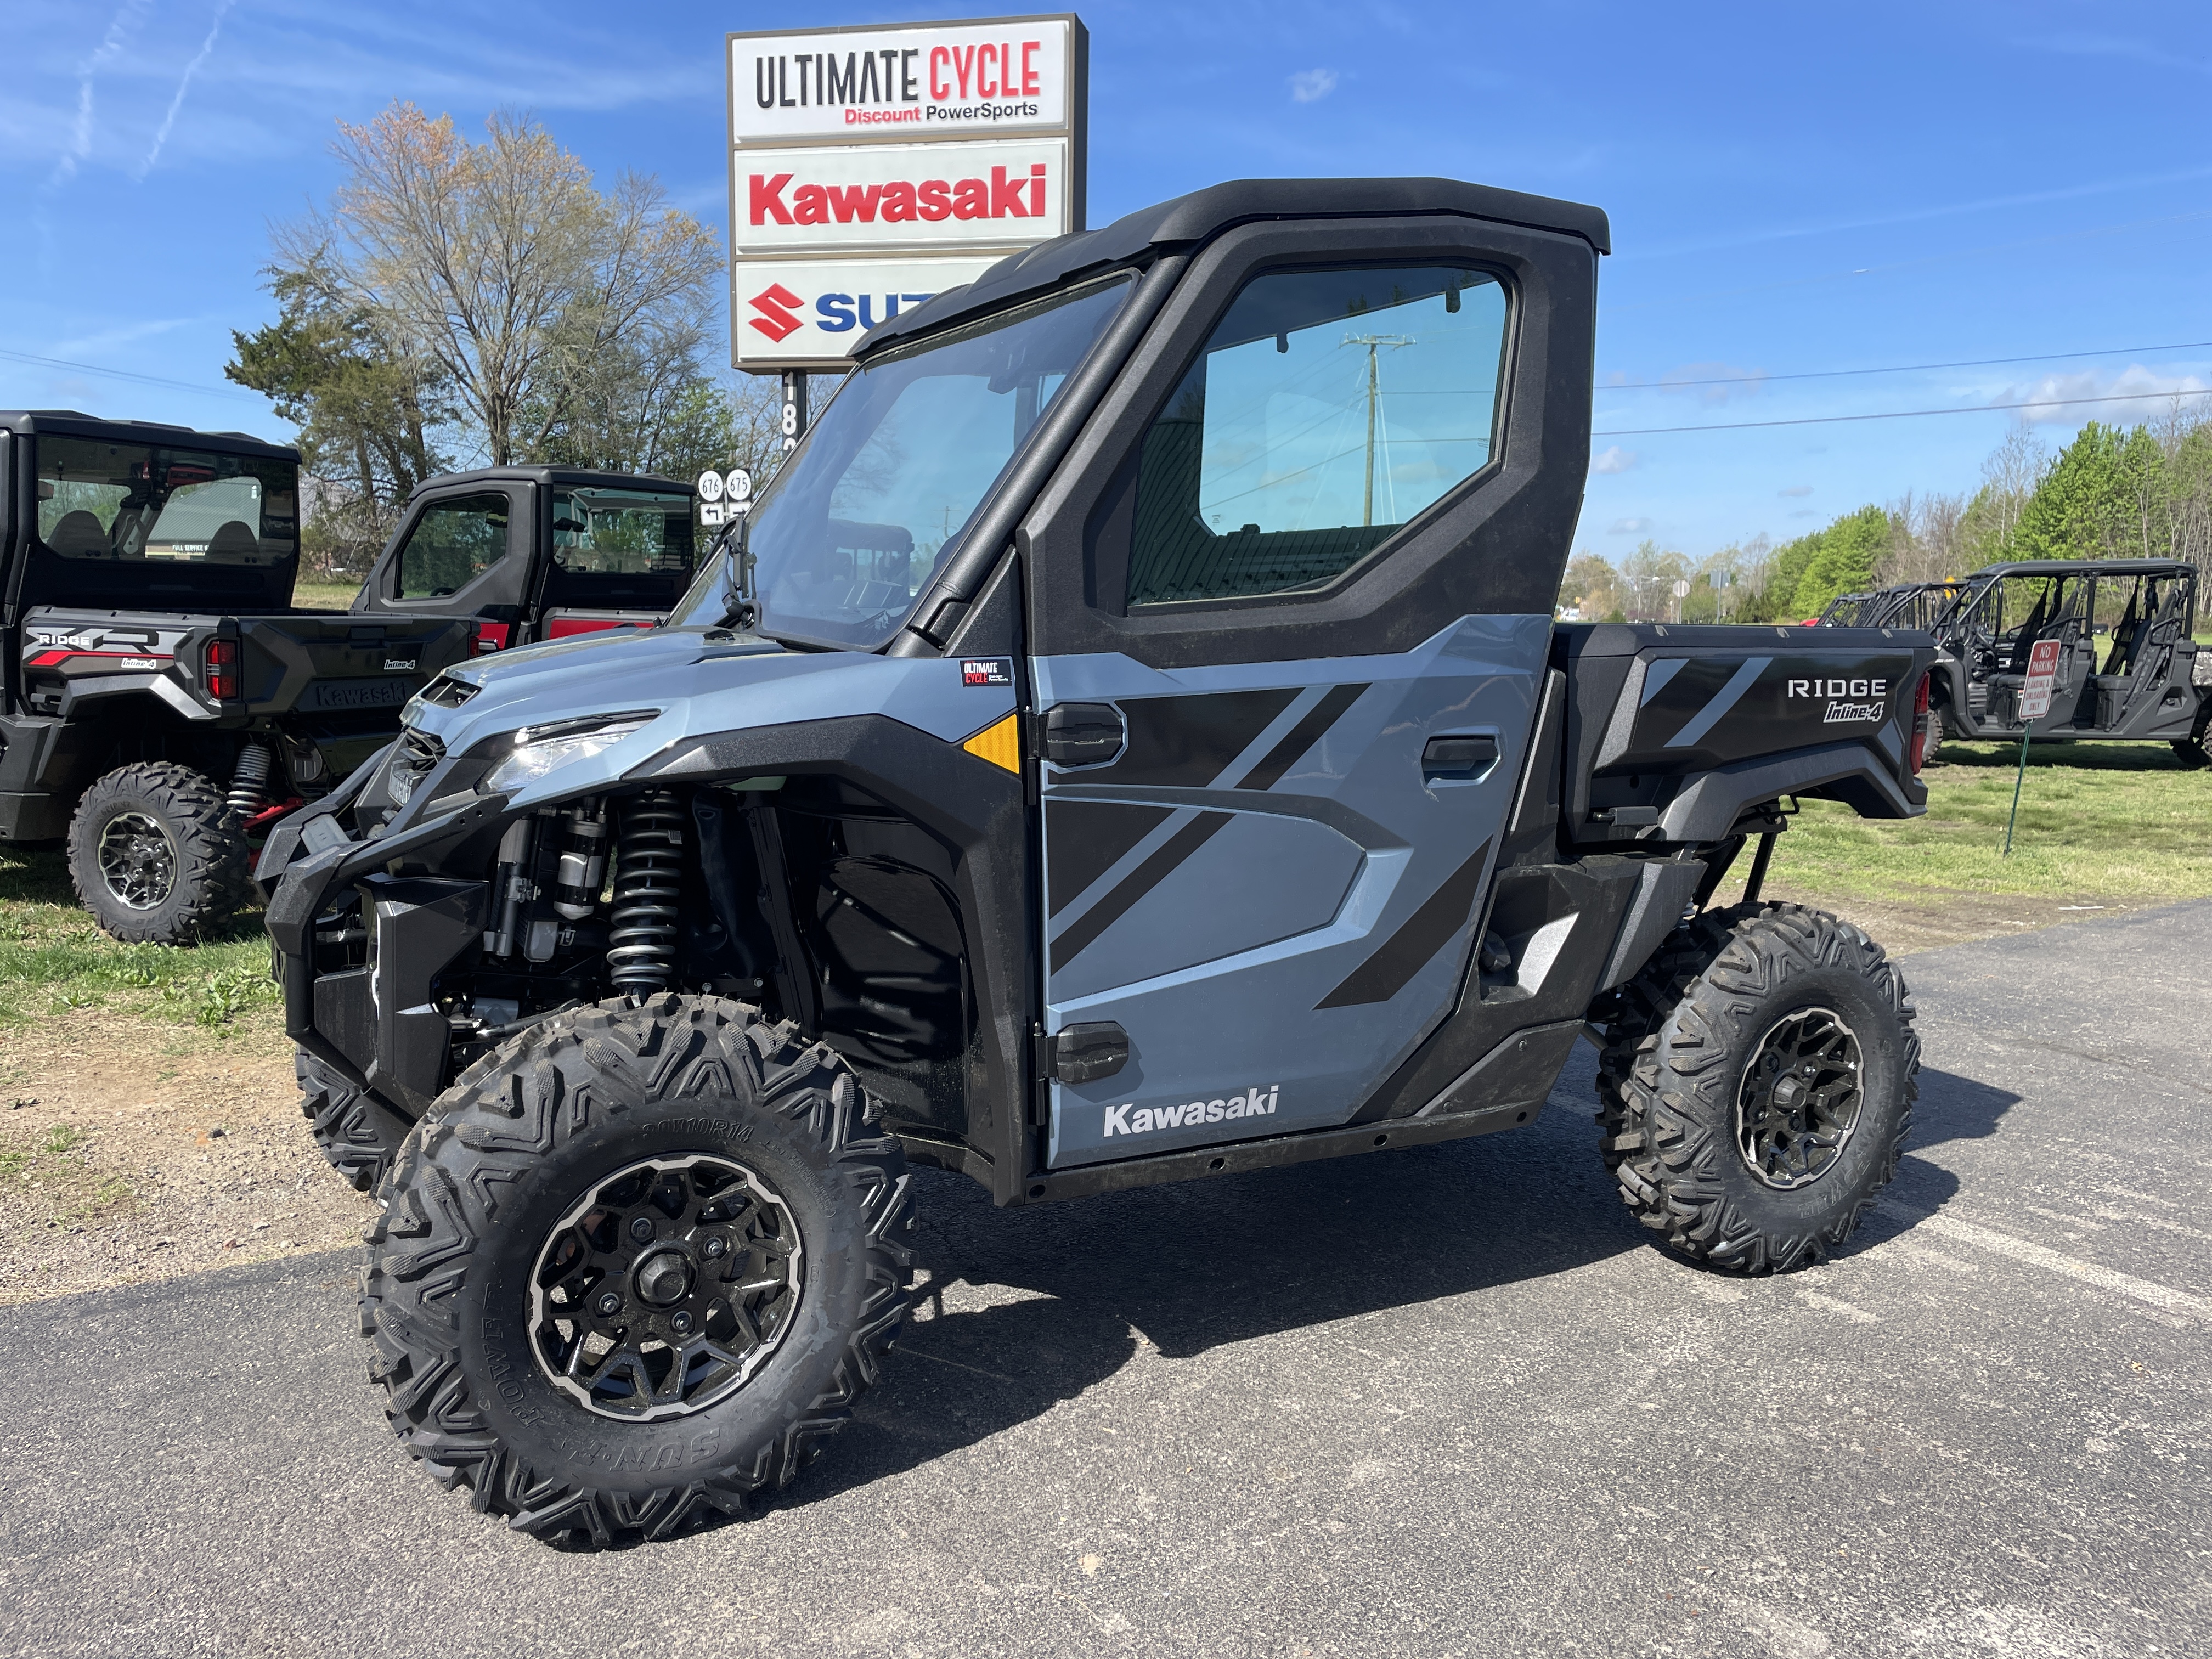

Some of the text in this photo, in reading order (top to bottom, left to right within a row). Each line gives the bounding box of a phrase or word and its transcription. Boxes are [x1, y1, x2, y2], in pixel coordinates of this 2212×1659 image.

[756, 41, 1041, 109] ULTIMATE CYCLE
[845, 101, 1038, 124] Discount PowerSports
[749, 163, 1046, 225] Kawasaki
[703, 478, 719, 493] 676
[730, 477, 747, 492] 675
[40, 634, 90, 645] RIDGE
[2039, 646, 2051, 659] NO
[964, 662, 998, 673] ULTIMATE
[2031, 659, 2055, 674] PARKING
[966, 673, 988, 684] CYCLE
[2028, 680, 2045, 689] LOADING
[316, 682, 408, 707] Kawasaki
[1788, 679, 1887, 698] RIDGE
[2025, 690, 2049, 701] UNLOADING
[1823, 701, 1885, 724] Inline-4
[2029, 702, 2041, 711] ONLY
[1103, 1085, 1279, 1137] Kawasaki
